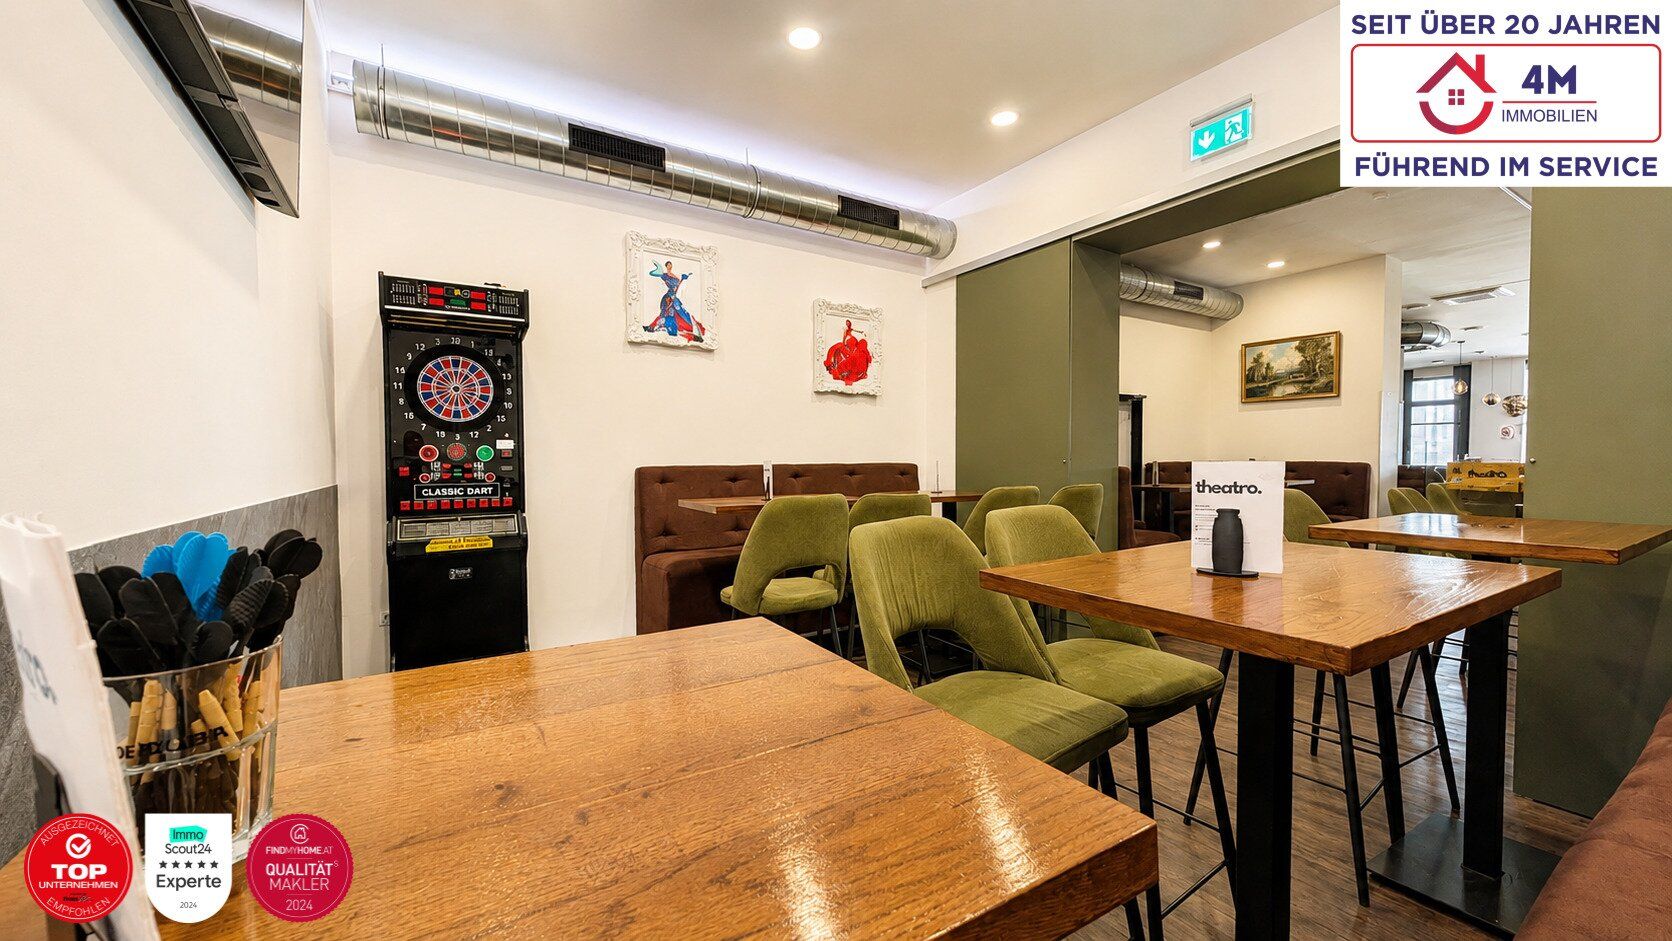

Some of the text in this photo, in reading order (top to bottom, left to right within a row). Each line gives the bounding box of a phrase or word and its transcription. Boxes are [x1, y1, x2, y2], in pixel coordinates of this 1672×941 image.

[421, 486, 493, 497] CLASSIC DART
[1195, 479, 1262, 495] theatro.
